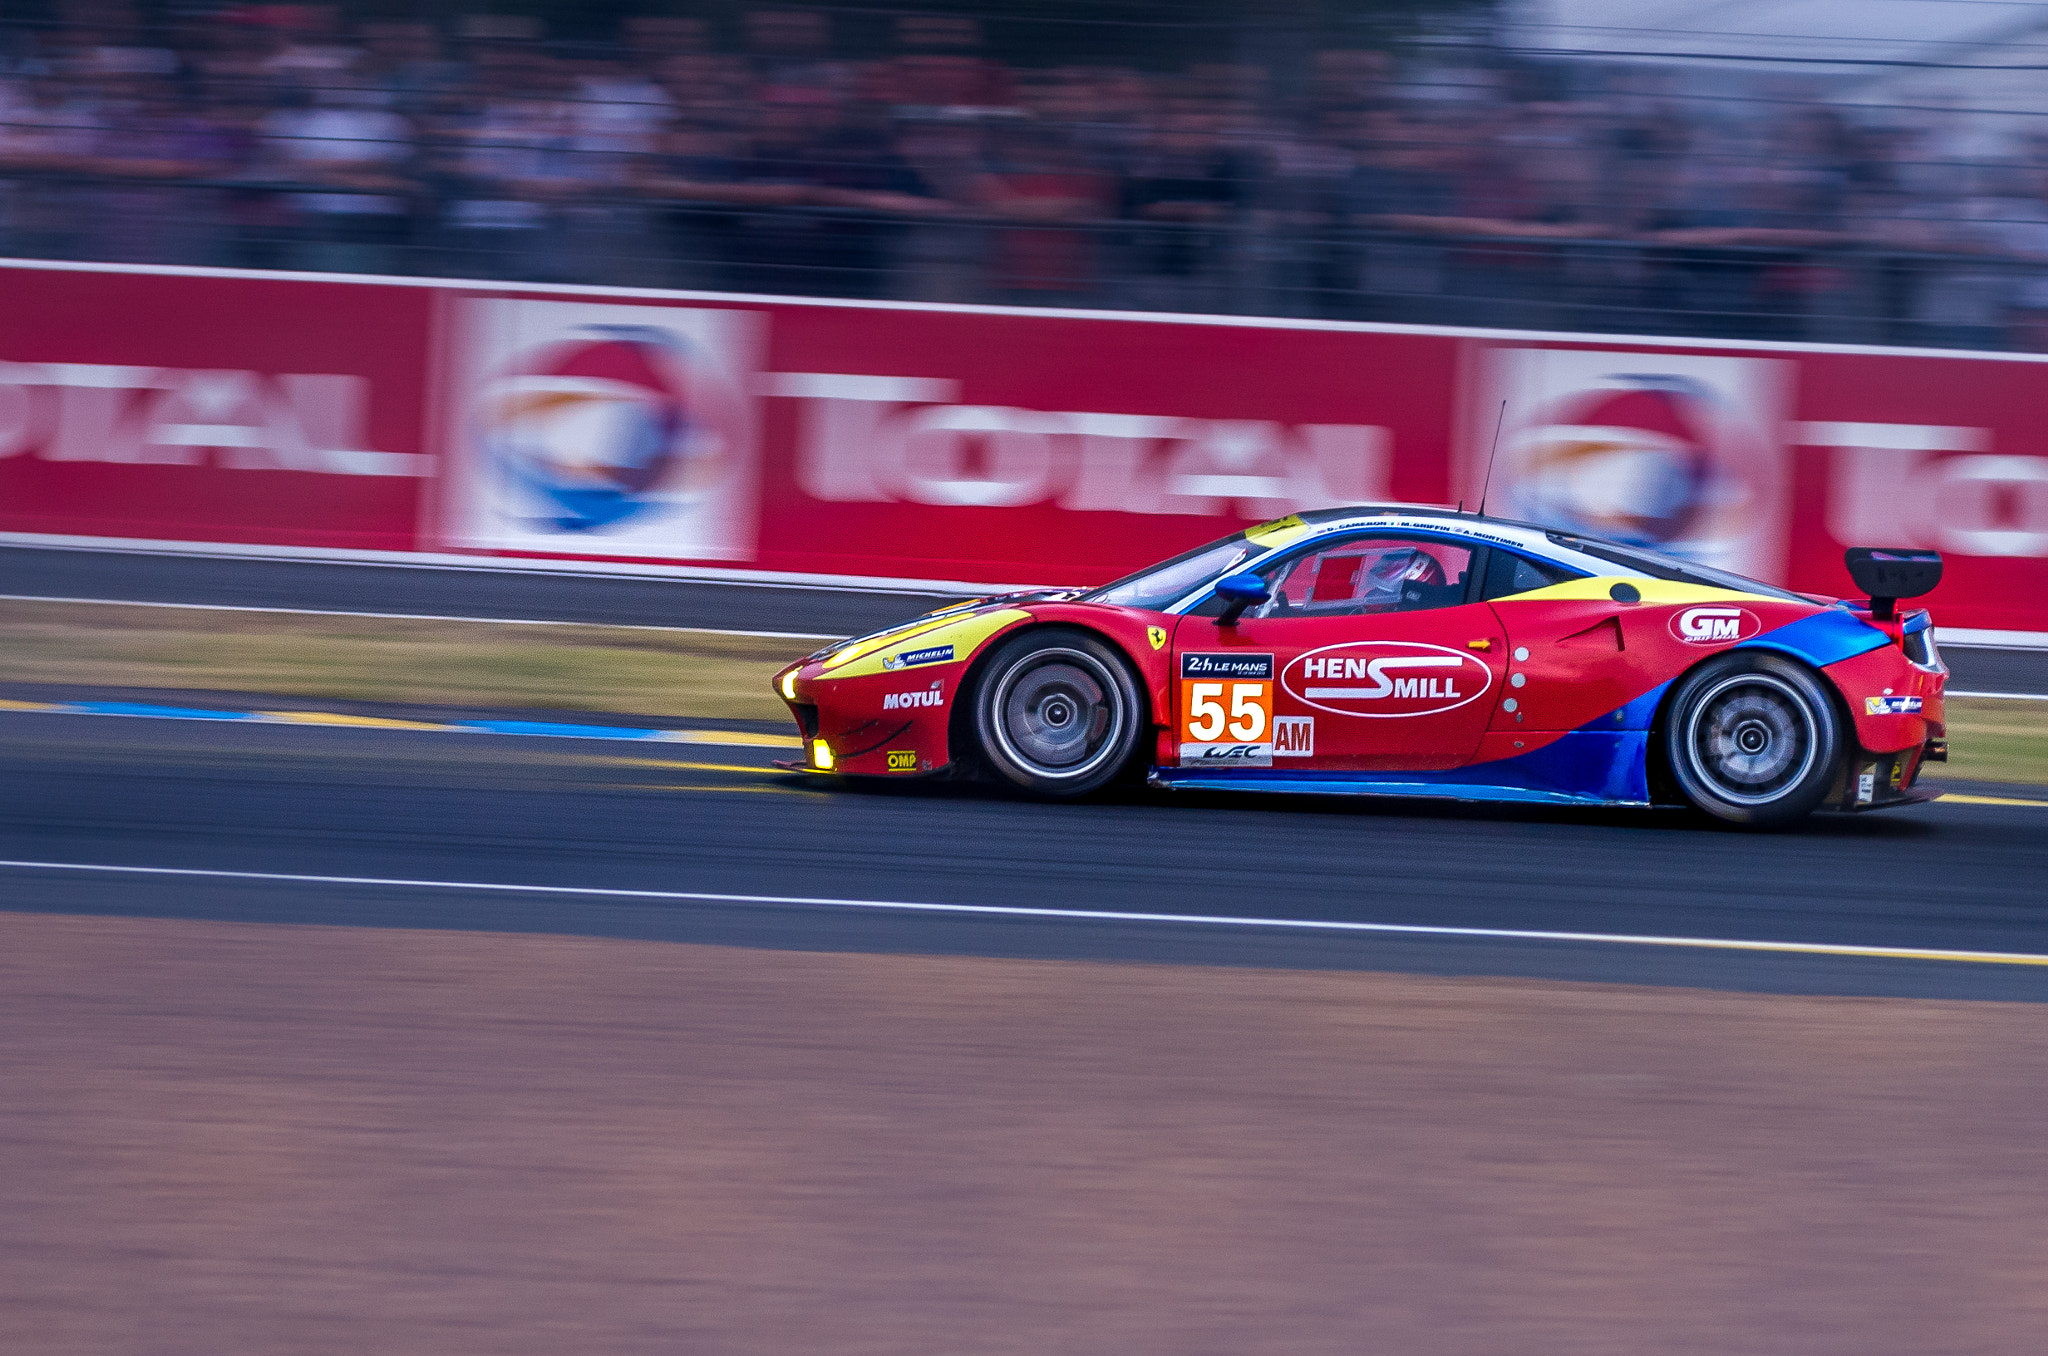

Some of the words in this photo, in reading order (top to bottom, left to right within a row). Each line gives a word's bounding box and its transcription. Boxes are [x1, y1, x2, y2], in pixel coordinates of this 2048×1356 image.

[1680, 608, 1742, 637] GM
[907, 648, 953, 662] MICHELIN
[1214, 662, 1230, 671] LE
[1231, 662, 1267, 672] MANS
[883, 690, 944, 710] MOTUL
[1188, 682, 1266, 742] 55
[1274, 722, 1311, 752] AM
[887, 754, 917, 768] OMP
